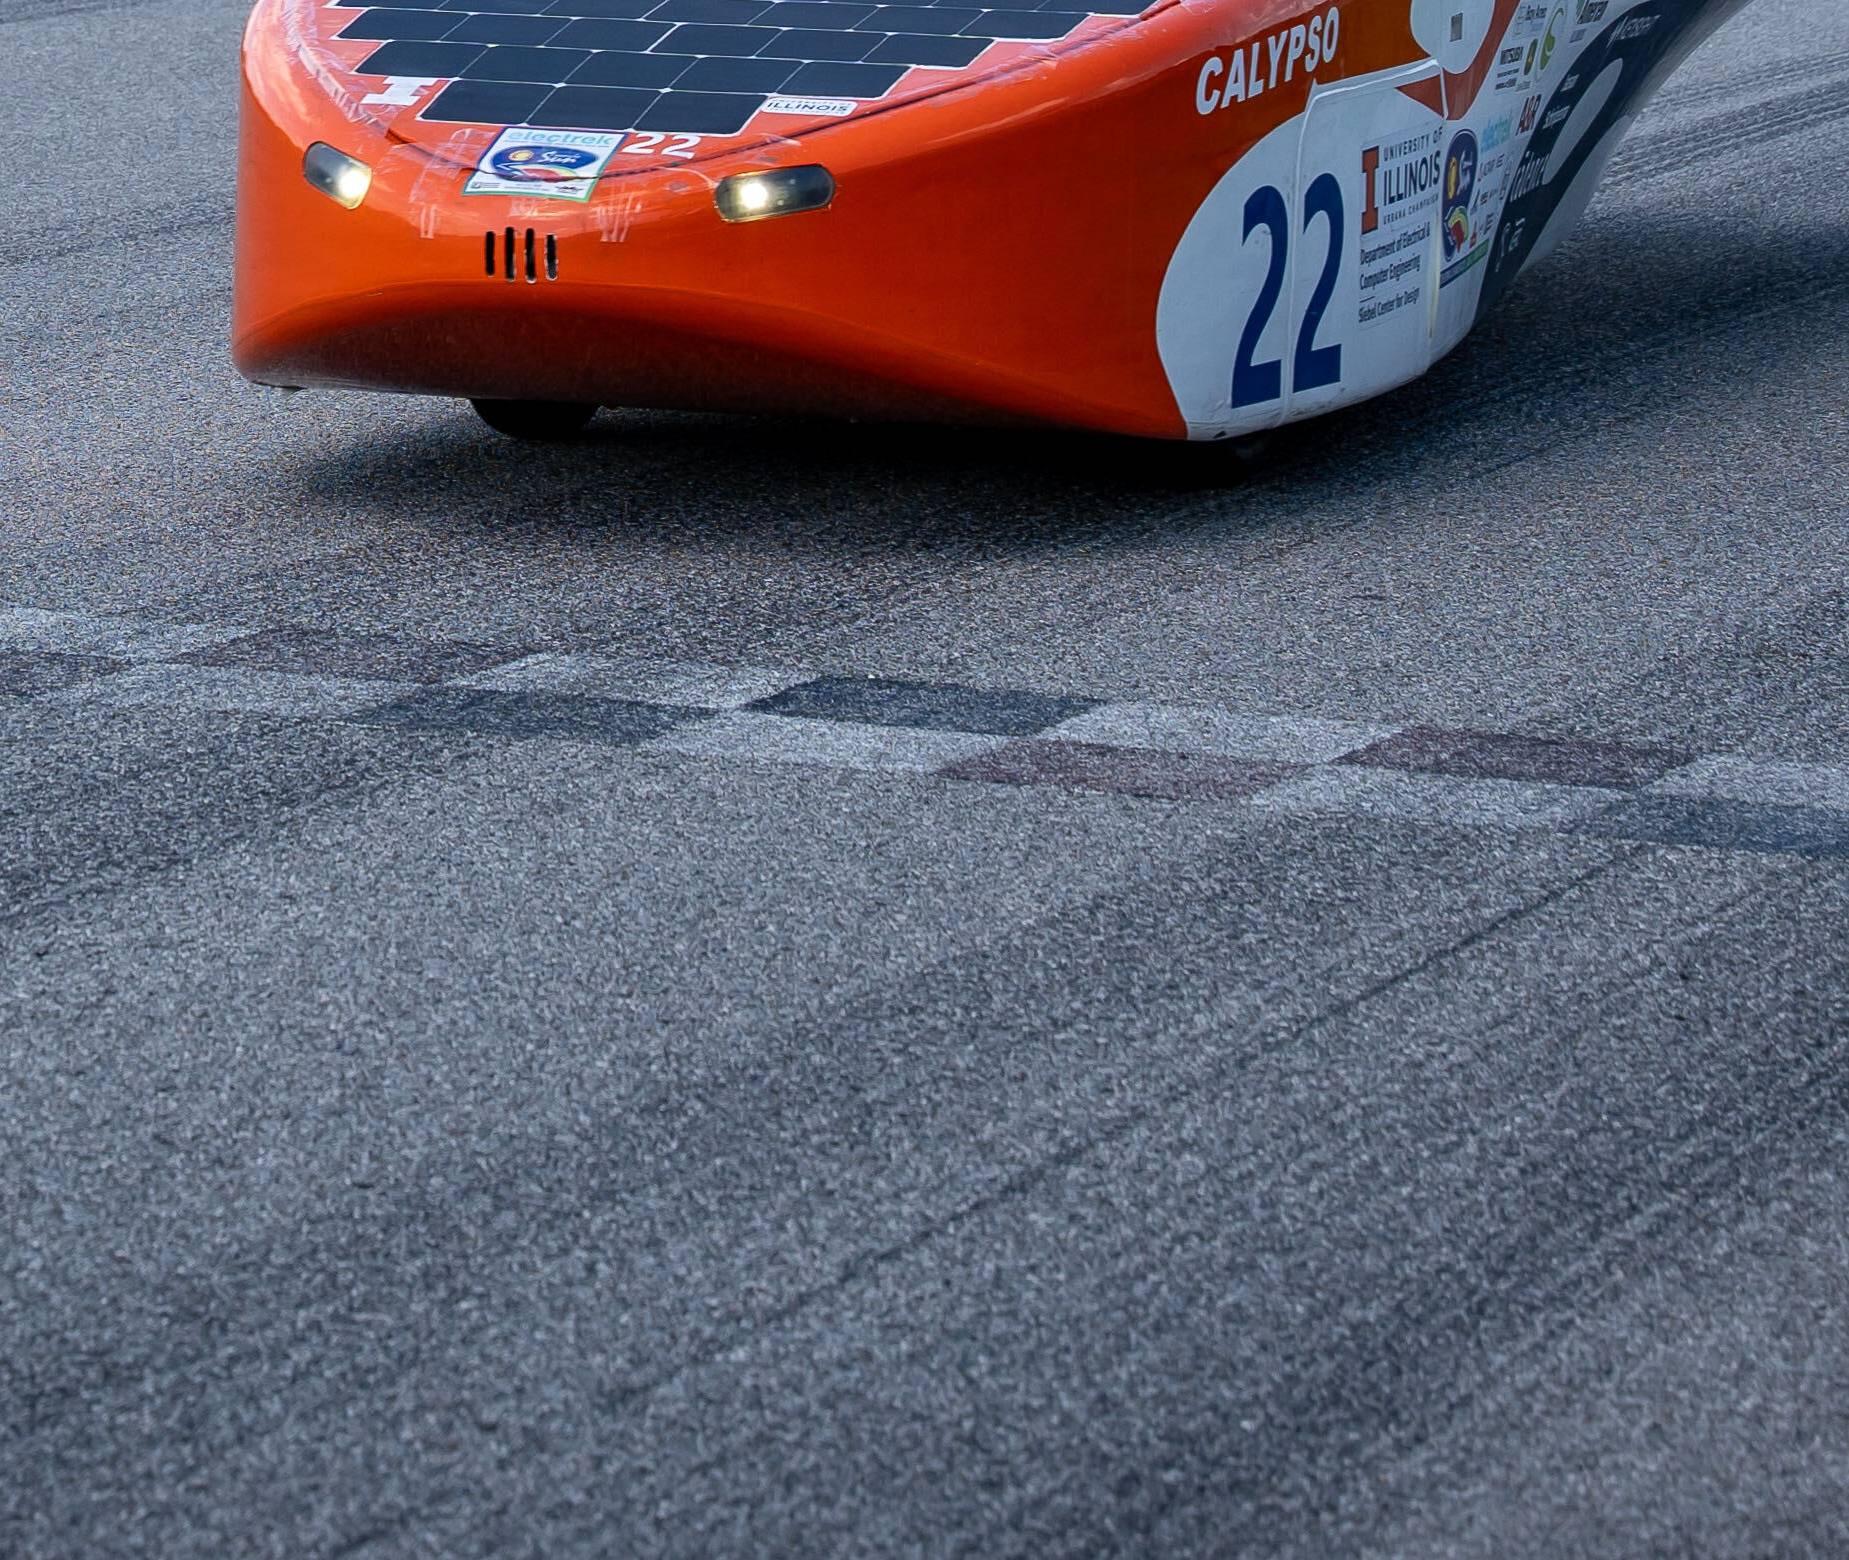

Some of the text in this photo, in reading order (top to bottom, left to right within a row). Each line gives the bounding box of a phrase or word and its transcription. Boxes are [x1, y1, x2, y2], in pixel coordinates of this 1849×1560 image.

[1195, 6, 1341, 116] CALYPSO
[767, 102, 849, 112] ILLINOIS
[508, 130, 612, 147] electrek
[622, 132, 701, 159] 22
[1383, 126, 1443, 161] UNIVERSITY OF
[1383, 150, 1441, 206] ILLINOIS
[1360, 240, 1395, 268] Department
[1360, 268, 1389, 291] Computer
[1389, 253, 1421, 282] Engineering
[1230, 173, 1345, 409] 22
